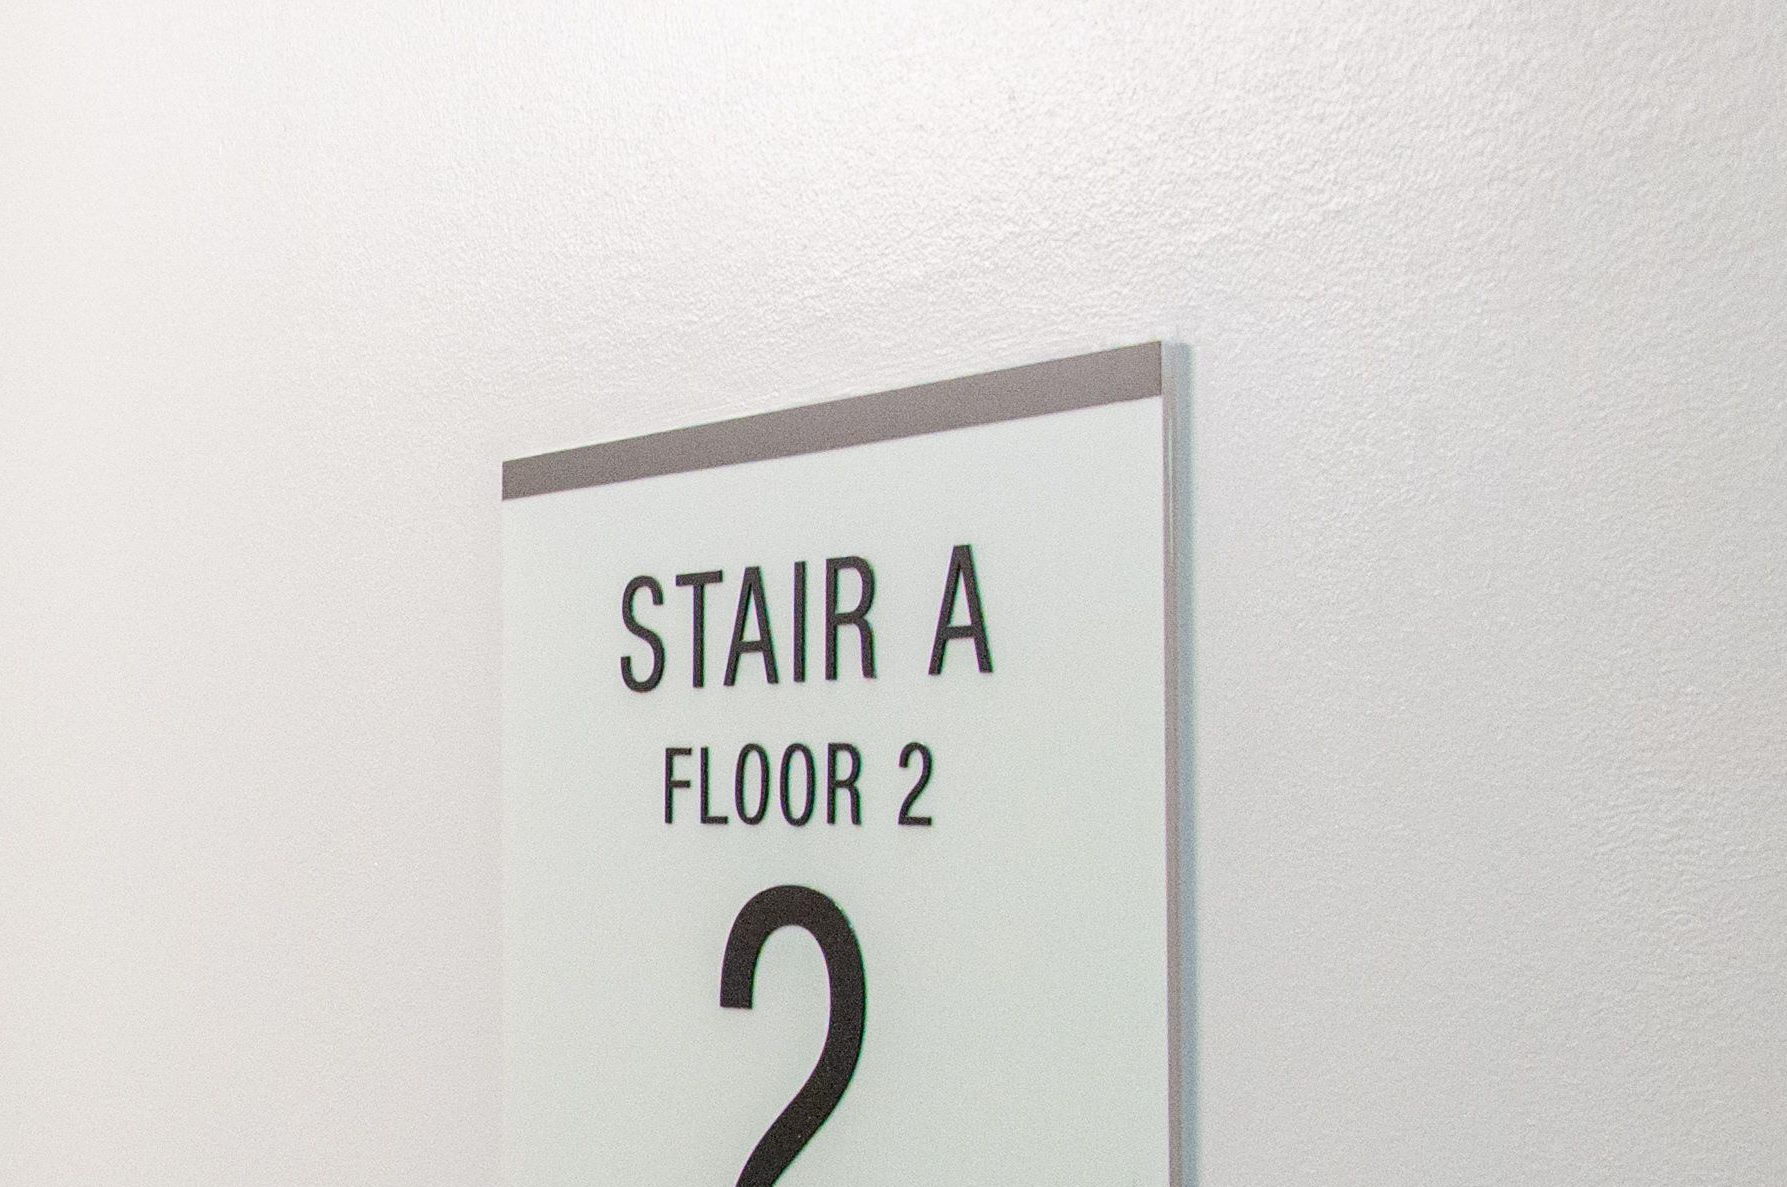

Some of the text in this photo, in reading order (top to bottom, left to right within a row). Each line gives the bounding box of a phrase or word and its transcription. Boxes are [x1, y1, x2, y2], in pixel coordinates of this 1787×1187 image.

[620, 544, 994, 694] STAIR A
[664, 741, 933, 829] FLOOR 2
